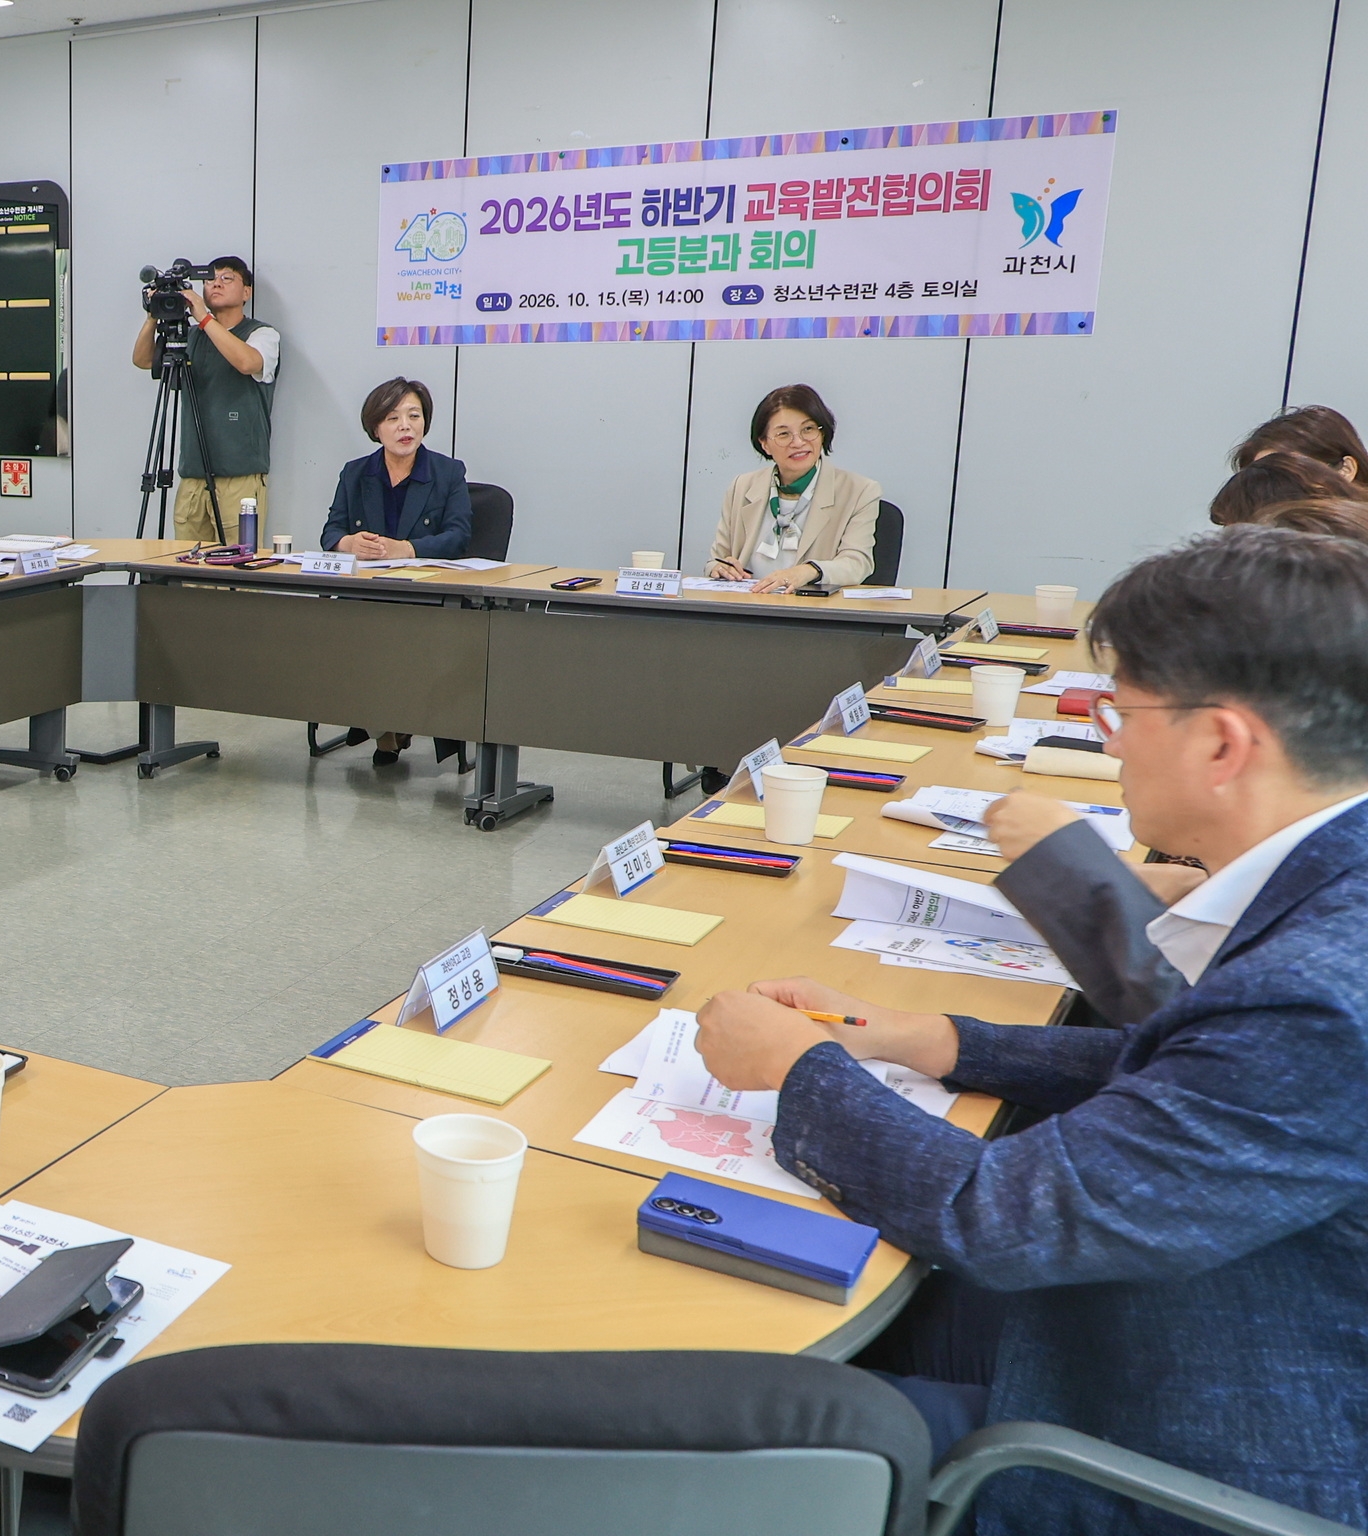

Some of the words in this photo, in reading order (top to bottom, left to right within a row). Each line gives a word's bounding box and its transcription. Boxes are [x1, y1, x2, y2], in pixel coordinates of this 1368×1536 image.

[480, 191, 631, 235] 2026년도
[641, 184, 736, 227] 하반기
[742, 168, 992, 222] 교육발전협의회
[615, 232, 741, 276] 고등분과
[749, 228, 817, 270] 회의
[1002, 254, 1077, 276] 과천시
[415, 281, 432, 291] Am
[434, 280, 463, 299] 과천
[773, 283, 879, 302] 청소년수련관
[885, 281, 915, 299] 4층
[921, 280, 979, 298] 토의실
[397, 291, 413, 301] We
[413, 291, 432, 301] Are
[519, 294, 560, 308] 2026.
[567, 293, 590, 307] 10.
[598, 289, 650, 307] 15.(목)
[657, 288, 704, 305] 14:00
[4, 463, 28, 471] 소화기
[313, 561, 342, 571] 신계용
[631, 580, 666, 592] 김선희
[623, 849, 652, 881] 김미정
[447, 968, 484, 1010] 정성용
[35, 1234, 70, 1248] 과천시
